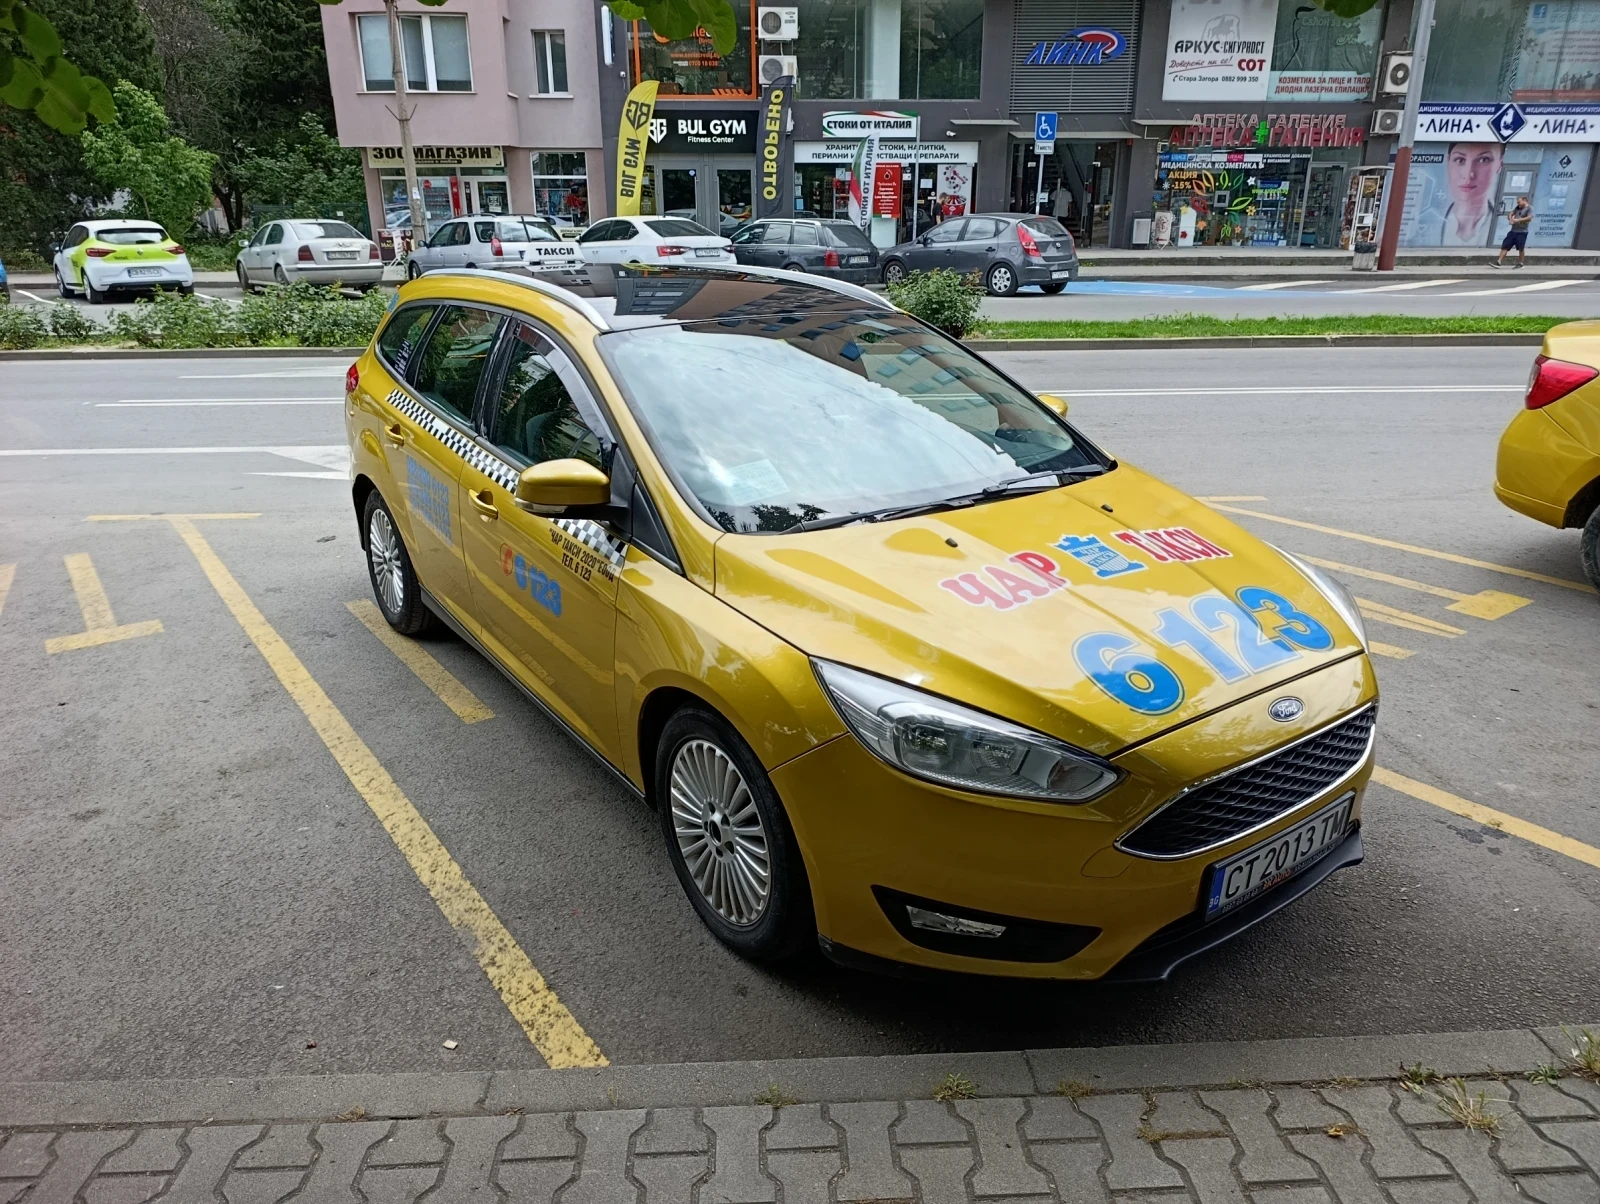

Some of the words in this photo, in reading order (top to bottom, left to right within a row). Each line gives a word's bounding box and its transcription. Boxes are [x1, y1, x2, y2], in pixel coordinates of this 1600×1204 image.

[1023, 41, 1112, 65] ЛИНК
[1174, 40, 1265, 54] АРКУС-СИГУРНОСТ
[1237, 58, 1266, 72] СОТ
[1178, 75, 1197, 83] Стара
[1198, 75, 1219, 83] Загора
[1328, 77, 1346, 85] ЛИЦЕ
[1275, 86, 1302, 94] ДИОДНА
[1304, 86, 1333, 94] ЛАЗЕРНА
[678, 119, 707, 134] BUL
[709, 119, 747, 135] GYM
[826, 120, 858, 129] СТОКИ
[860, 120, 873, 129] ОТ
[874, 120, 912, 129] ИТАЛИЯ
[1191, 113, 1259, 128] АПТЕКА
[1266, 114, 1347, 128] ГАЛЕНИЯ
[1425, 118, 1474, 133] ЛИНА
[1539, 119, 1588, 134] ЛИНА
[1168, 126, 1252, 147] АПТЕКА
[1268, 126, 1364, 147] ГАЛЕНИЯ
[878, 144, 906, 152] СТОКИ,
[864, 138, 875, 179] ИТАЛИЯ
[1214, 162, 1257, 170] КОЗМЕТИКА
[1168, 171, 1198, 179] АКЦИЯ
[1551, 171, 1576, 179] ЛИНА
[863, 180, 870, 194] ОТ
[1171, 181, 1192, 190] -15%
[535, 247, 575, 256] ТАКСИ
[562, 537, 582, 560] ТАКСИ
[1112, 526, 1233, 562] ТАКСИ
[561, 553, 574, 571] ТЕЛ.
[574, 561, 579, 574] 6
[580, 565, 592, 582] 123
[515, 553, 527, 590] 6
[529, 564, 562, 618] 123
[939, 550, 1069, 611] ЧАР
[1072, 631, 1186, 717] 6
[1147, 585, 1336, 686] 123
[1276, 703, 1300, 717] Ford
[1225, 854, 1262, 900] CT
[1260, 825, 1315, 882] 2013
[1319, 806, 1349, 847] TM
[1209, 895, 1220, 908] BG
